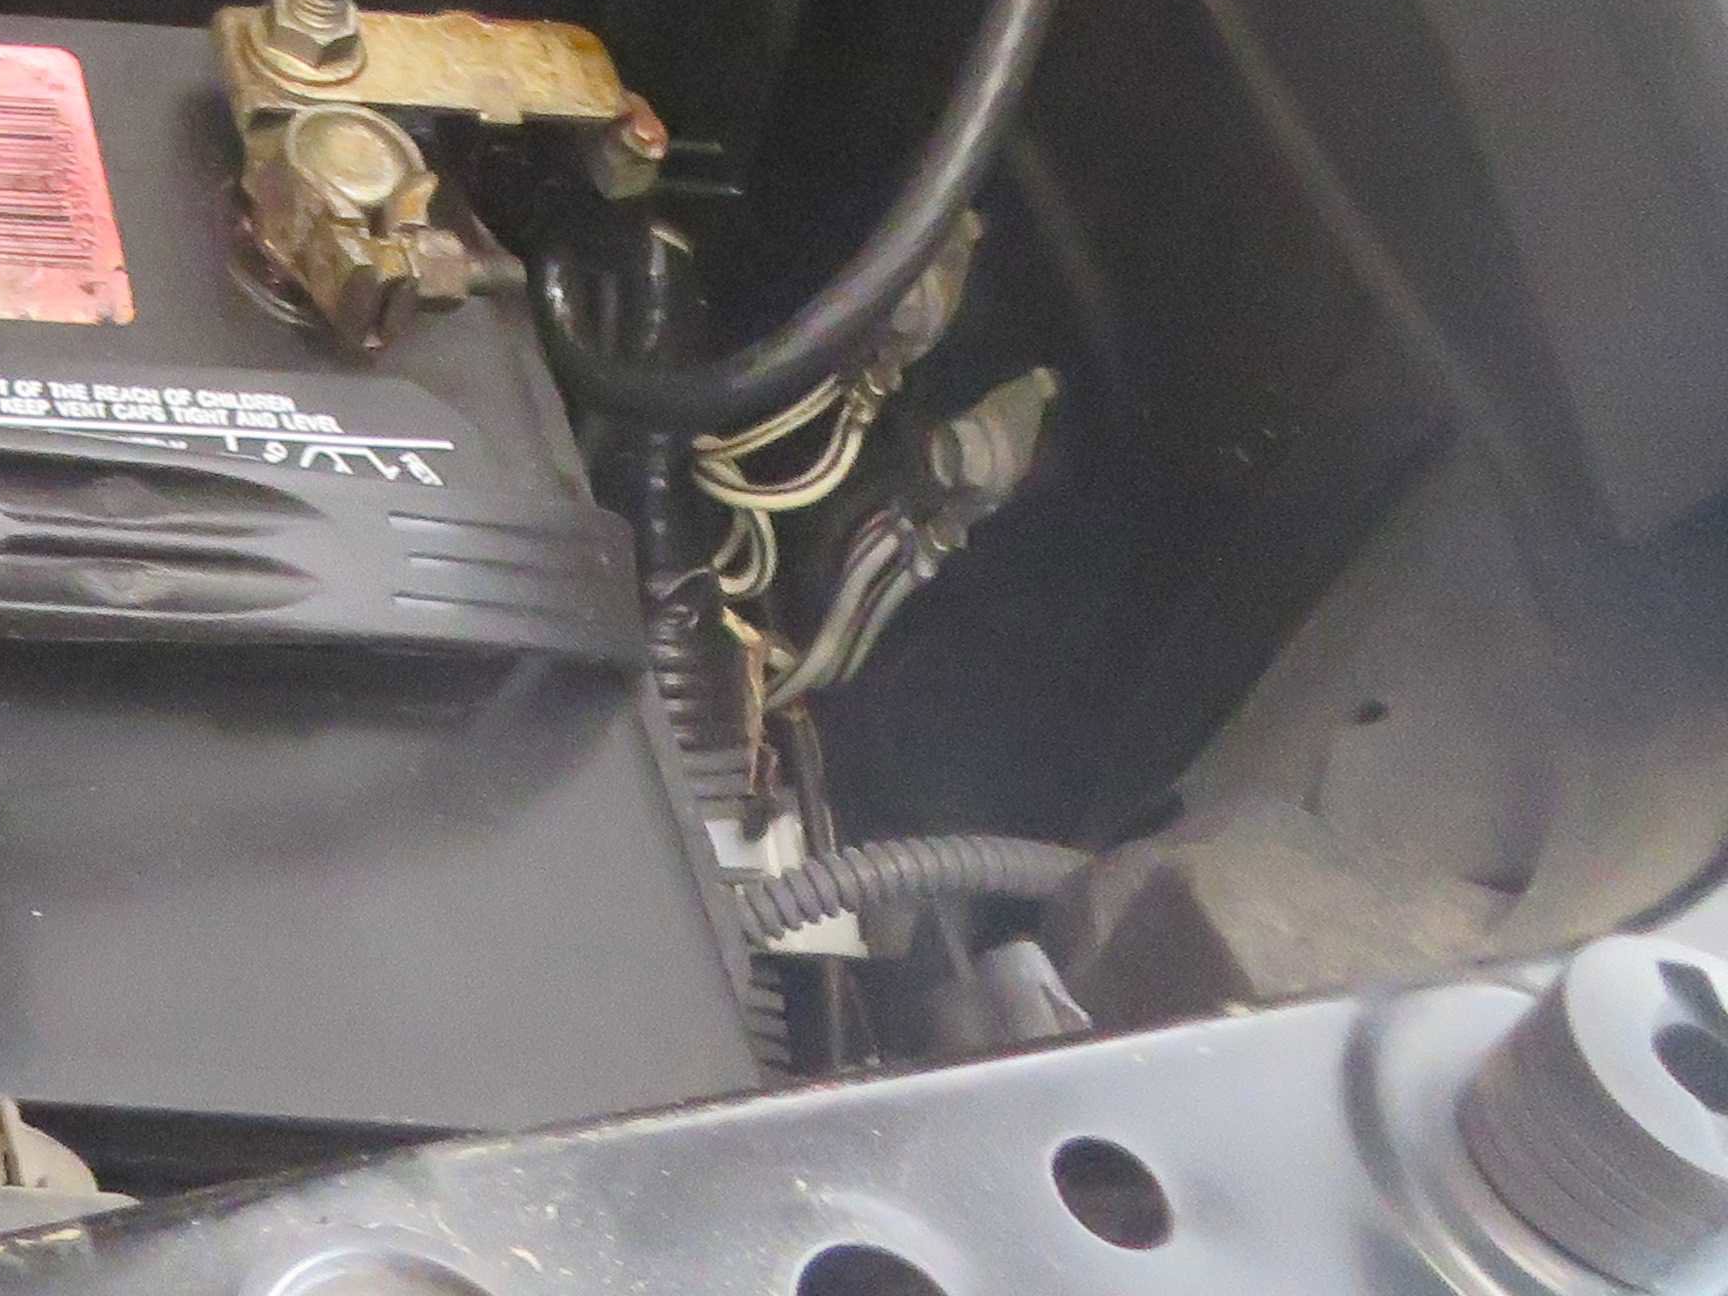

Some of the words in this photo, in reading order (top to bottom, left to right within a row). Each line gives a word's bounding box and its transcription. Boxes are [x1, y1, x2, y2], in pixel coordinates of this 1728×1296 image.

[14, 380, 44, 398] OF
[46, 381, 90, 400] THE
[93, 384, 160, 405] REACH
[163, 387, 193, 407] OF
[195, 389, 295, 413] CHILDREN
[55, 400, 107, 419] VENT
[111, 402, 168, 423] CAPS
[171, 405, 230, 426] TIGHT
[235, 409, 279, 429] AND
[280, 412, 345, 434] LEVEL
